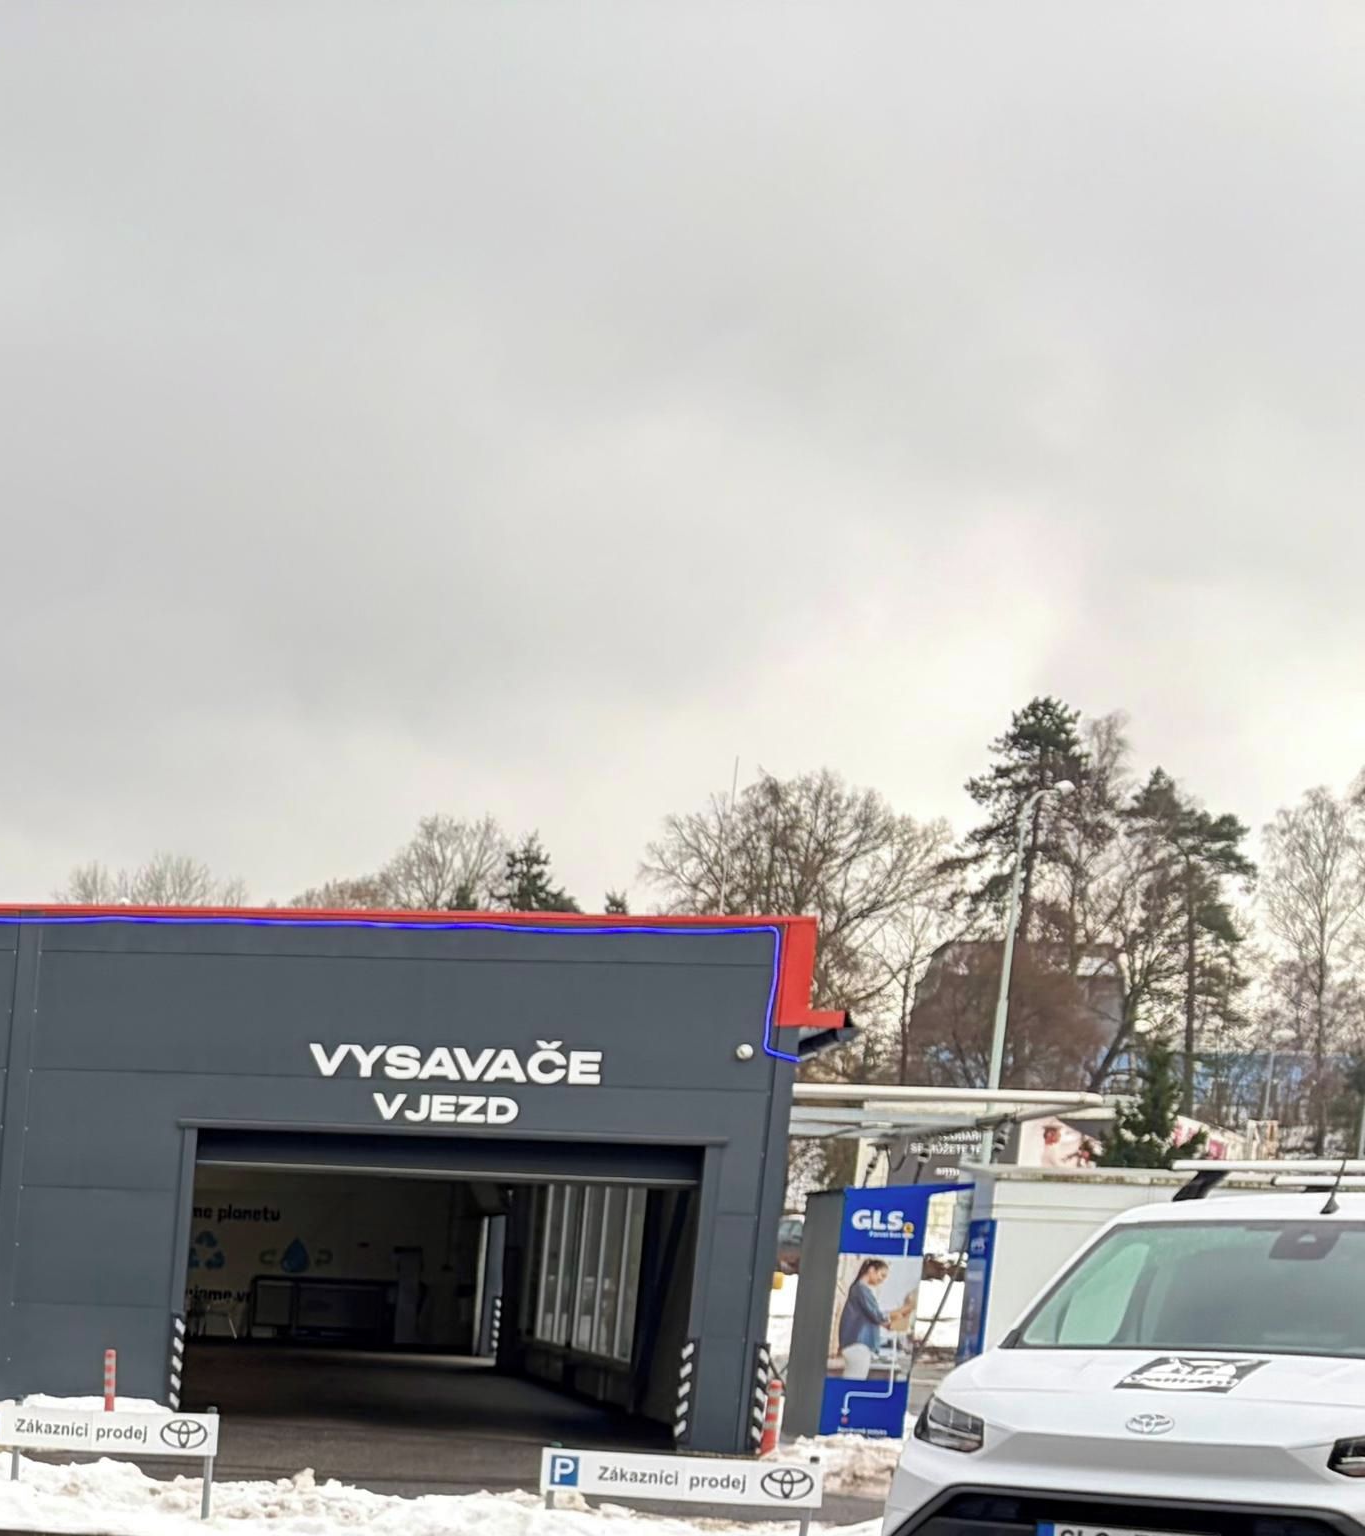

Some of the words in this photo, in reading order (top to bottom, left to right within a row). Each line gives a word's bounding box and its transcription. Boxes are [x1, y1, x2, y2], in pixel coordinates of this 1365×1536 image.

[309, 1040, 603, 1085] VYSAVAČE
[217, 1203, 281, 1222] planetu
[16, 1418, 88, 1438] Zákazníci
[96, 1425, 147, 1444] prodej
[554, 1458, 575, 1483] P
[597, 1466, 679, 1486] Zákazníci
[689, 1473, 746, 1494] prodej
